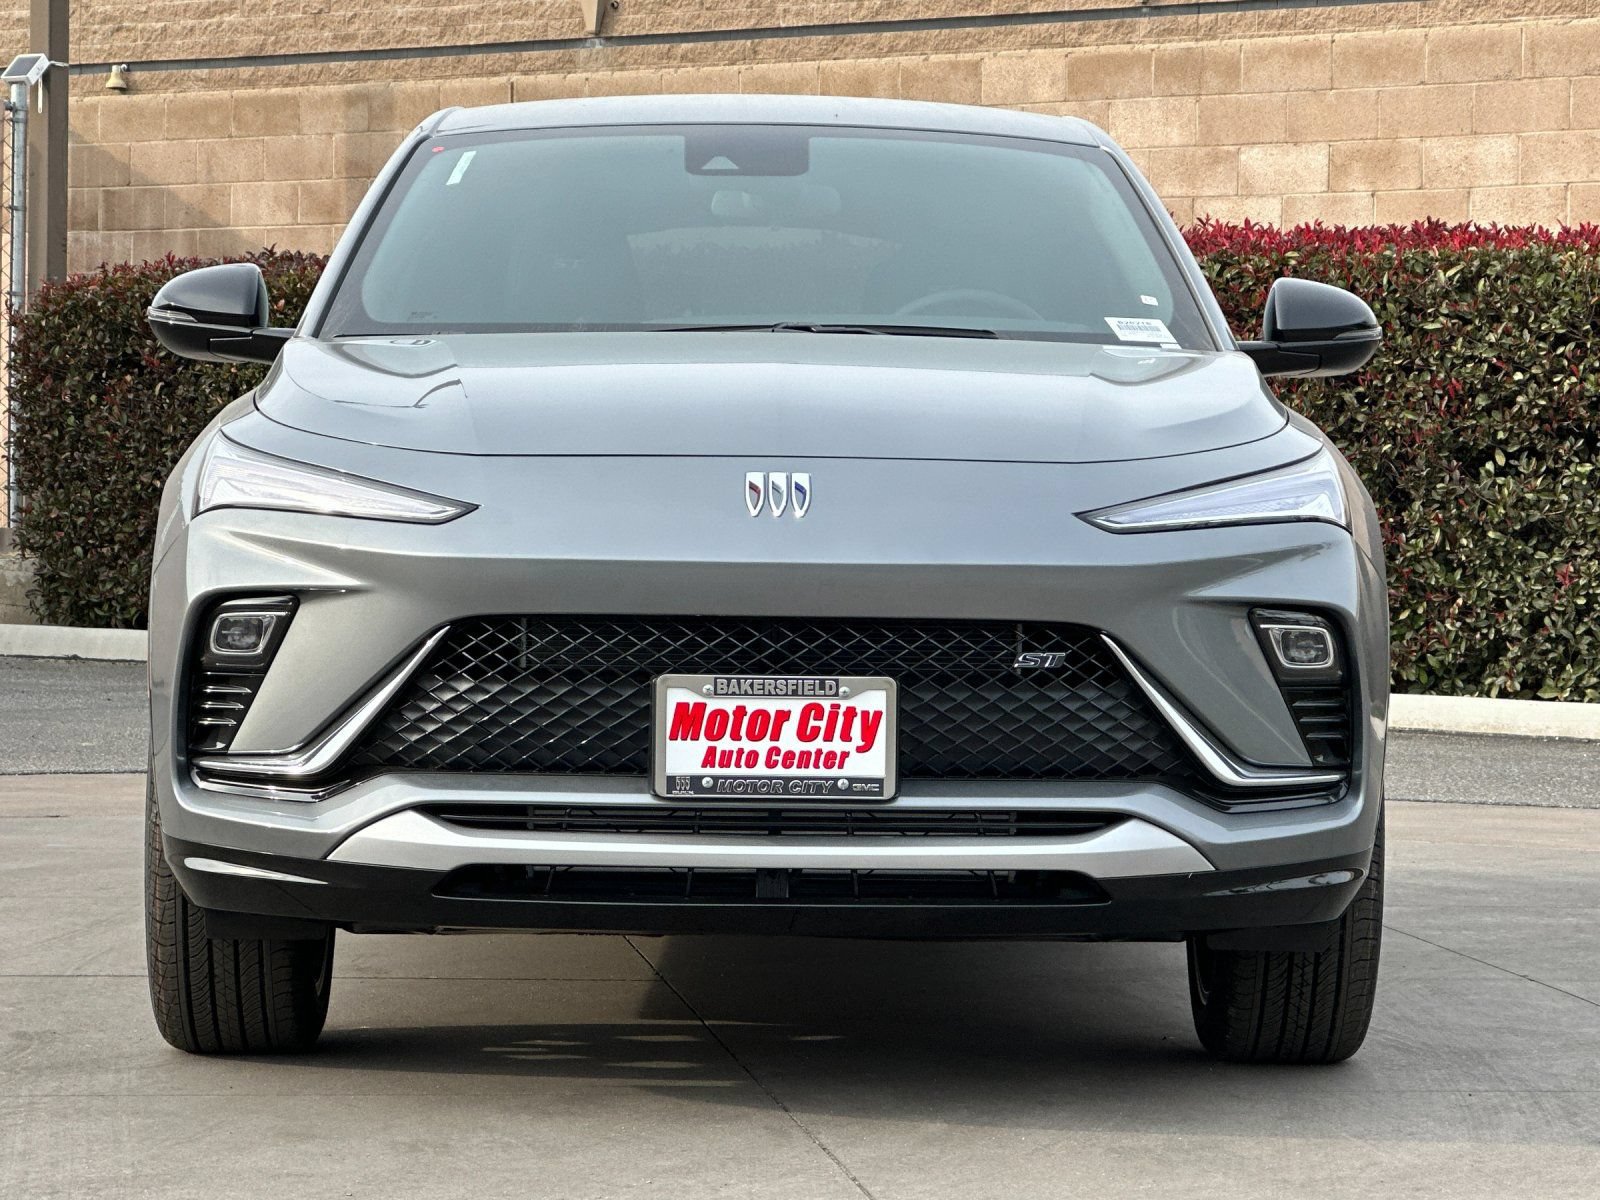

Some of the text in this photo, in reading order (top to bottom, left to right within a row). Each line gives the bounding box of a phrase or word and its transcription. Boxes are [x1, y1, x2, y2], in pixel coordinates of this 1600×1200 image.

[1014, 653, 1066, 668] ST
[716, 679, 836, 695] BAKERSFIELD
[669, 702, 882, 753] Motor City
[701, 746, 850, 769] Auto Center
[717, 780, 835, 794] MOTOR CITY
[852, 783, 880, 791] GMC
